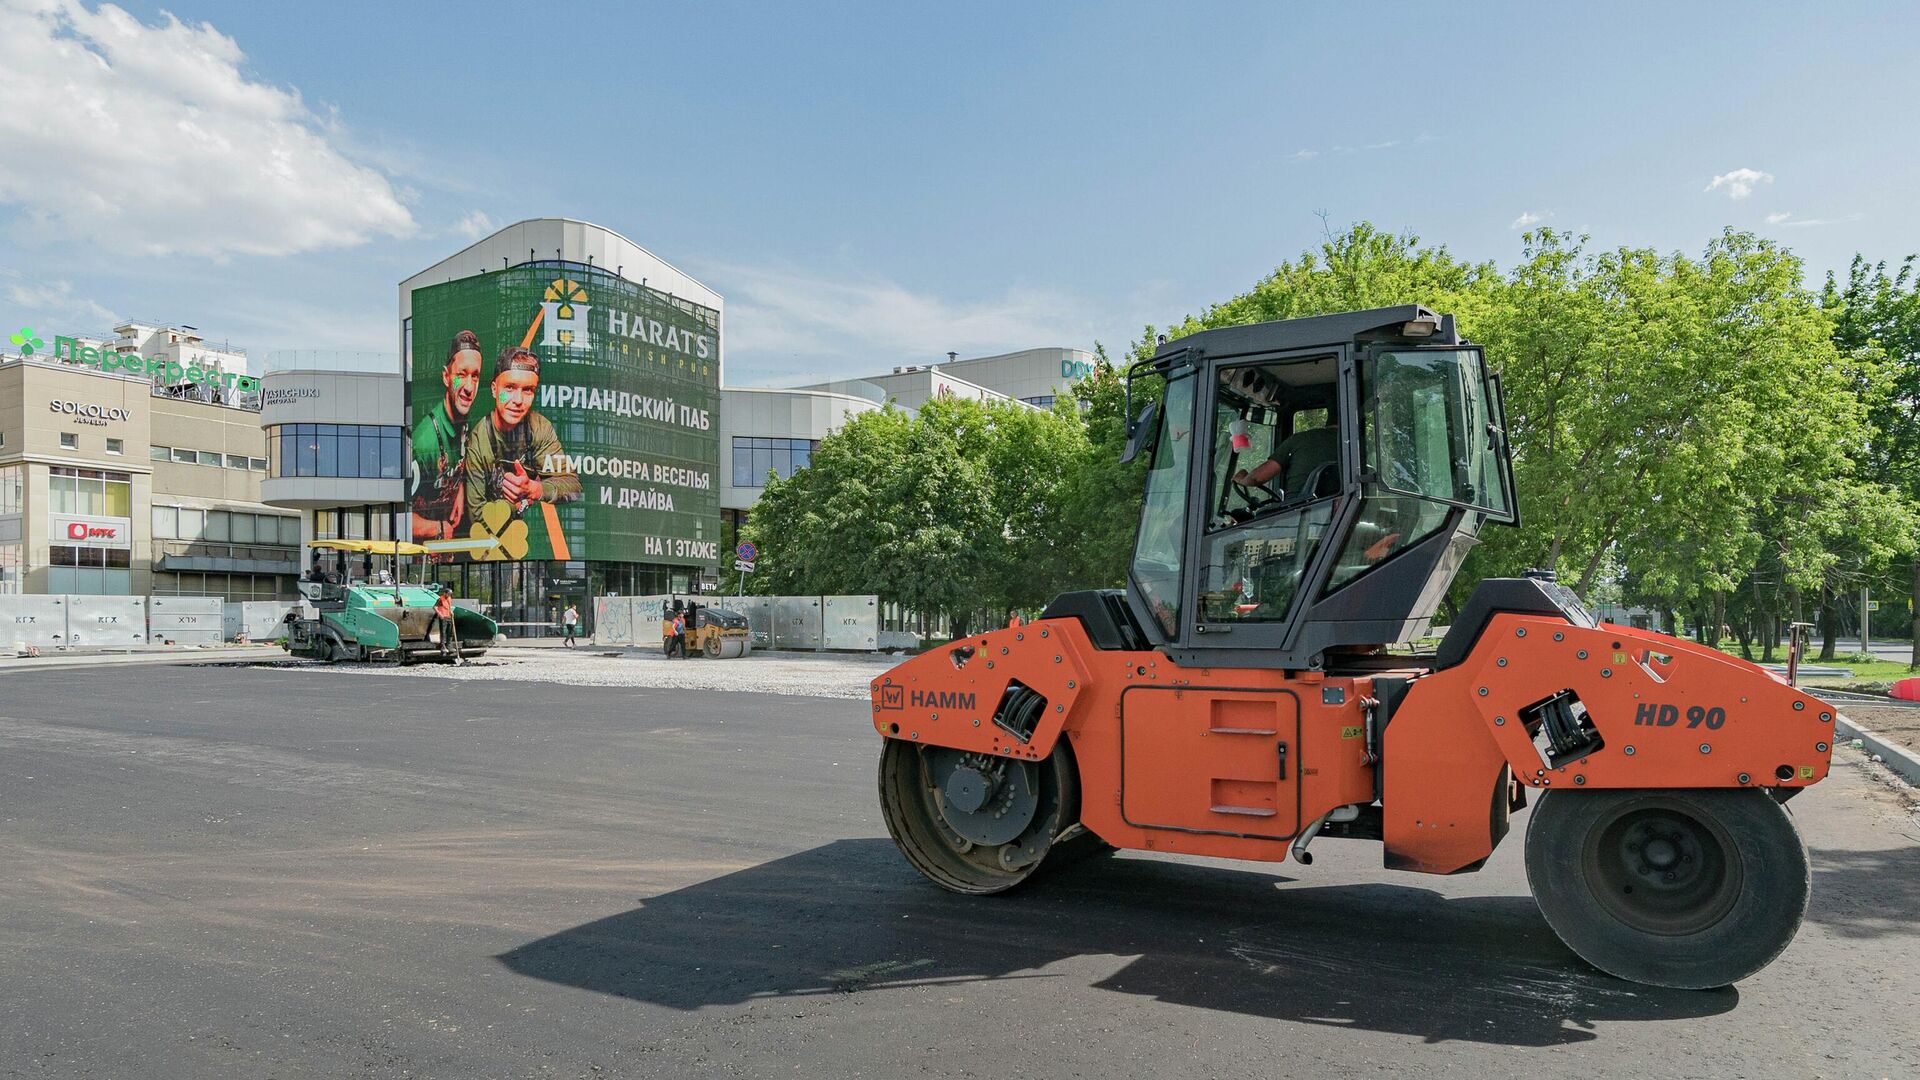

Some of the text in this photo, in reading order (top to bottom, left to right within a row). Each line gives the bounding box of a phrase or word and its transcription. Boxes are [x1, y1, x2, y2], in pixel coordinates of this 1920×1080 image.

[55, 335, 261, 393] Перекрёсто
[608, 341, 708, 376] IRISH PUB
[50, 399, 132, 422] SOKOLOV
[541, 385, 710, 431] ИРЛАНДСКИЙ ПАБ
[541, 454, 710, 490] АТМОСФЕРА ВЕСЕЛЬЯ
[600, 486, 675, 512] И ДРАЙВА
[89, 527, 117, 538] МТС
[645, 537, 717, 560] НА 1 ЭТАЖЕ
[910, 690, 976, 710] HAMM
[1634, 703, 1726, 730] HD 90
